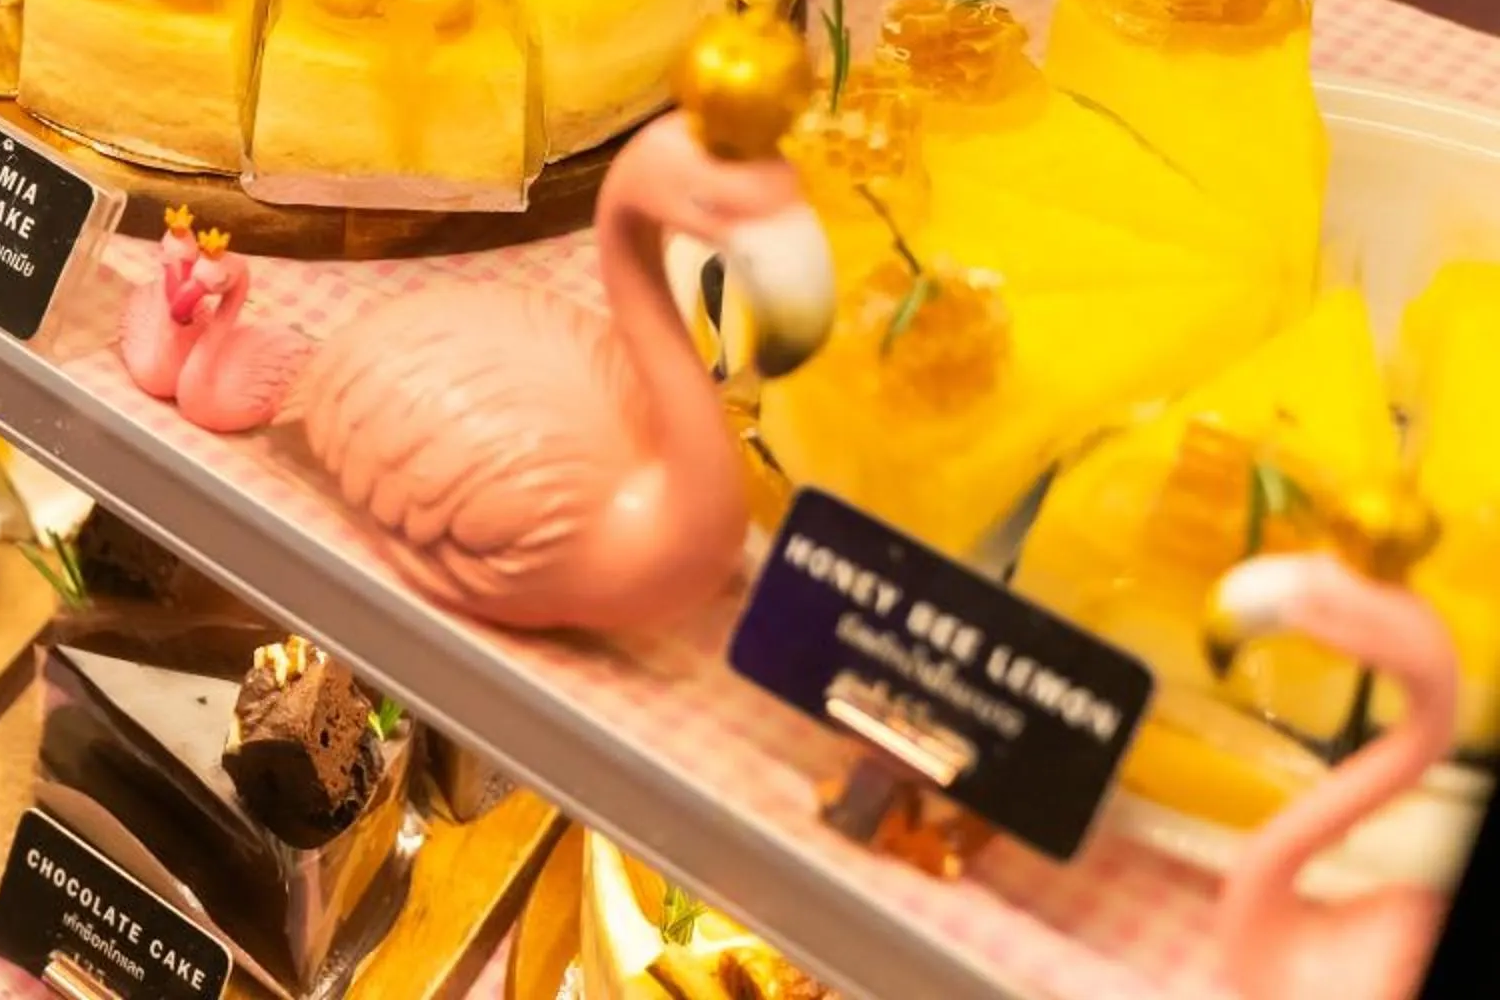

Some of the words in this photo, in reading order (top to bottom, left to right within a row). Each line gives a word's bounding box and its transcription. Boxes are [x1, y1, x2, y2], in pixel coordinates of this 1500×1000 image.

[784, 533, 901, 615] HONEY
[986, 645, 1123, 740] LEMON
[26, 848, 143, 944] CHOCOLATE
[149, 939, 207, 991] CAKE
